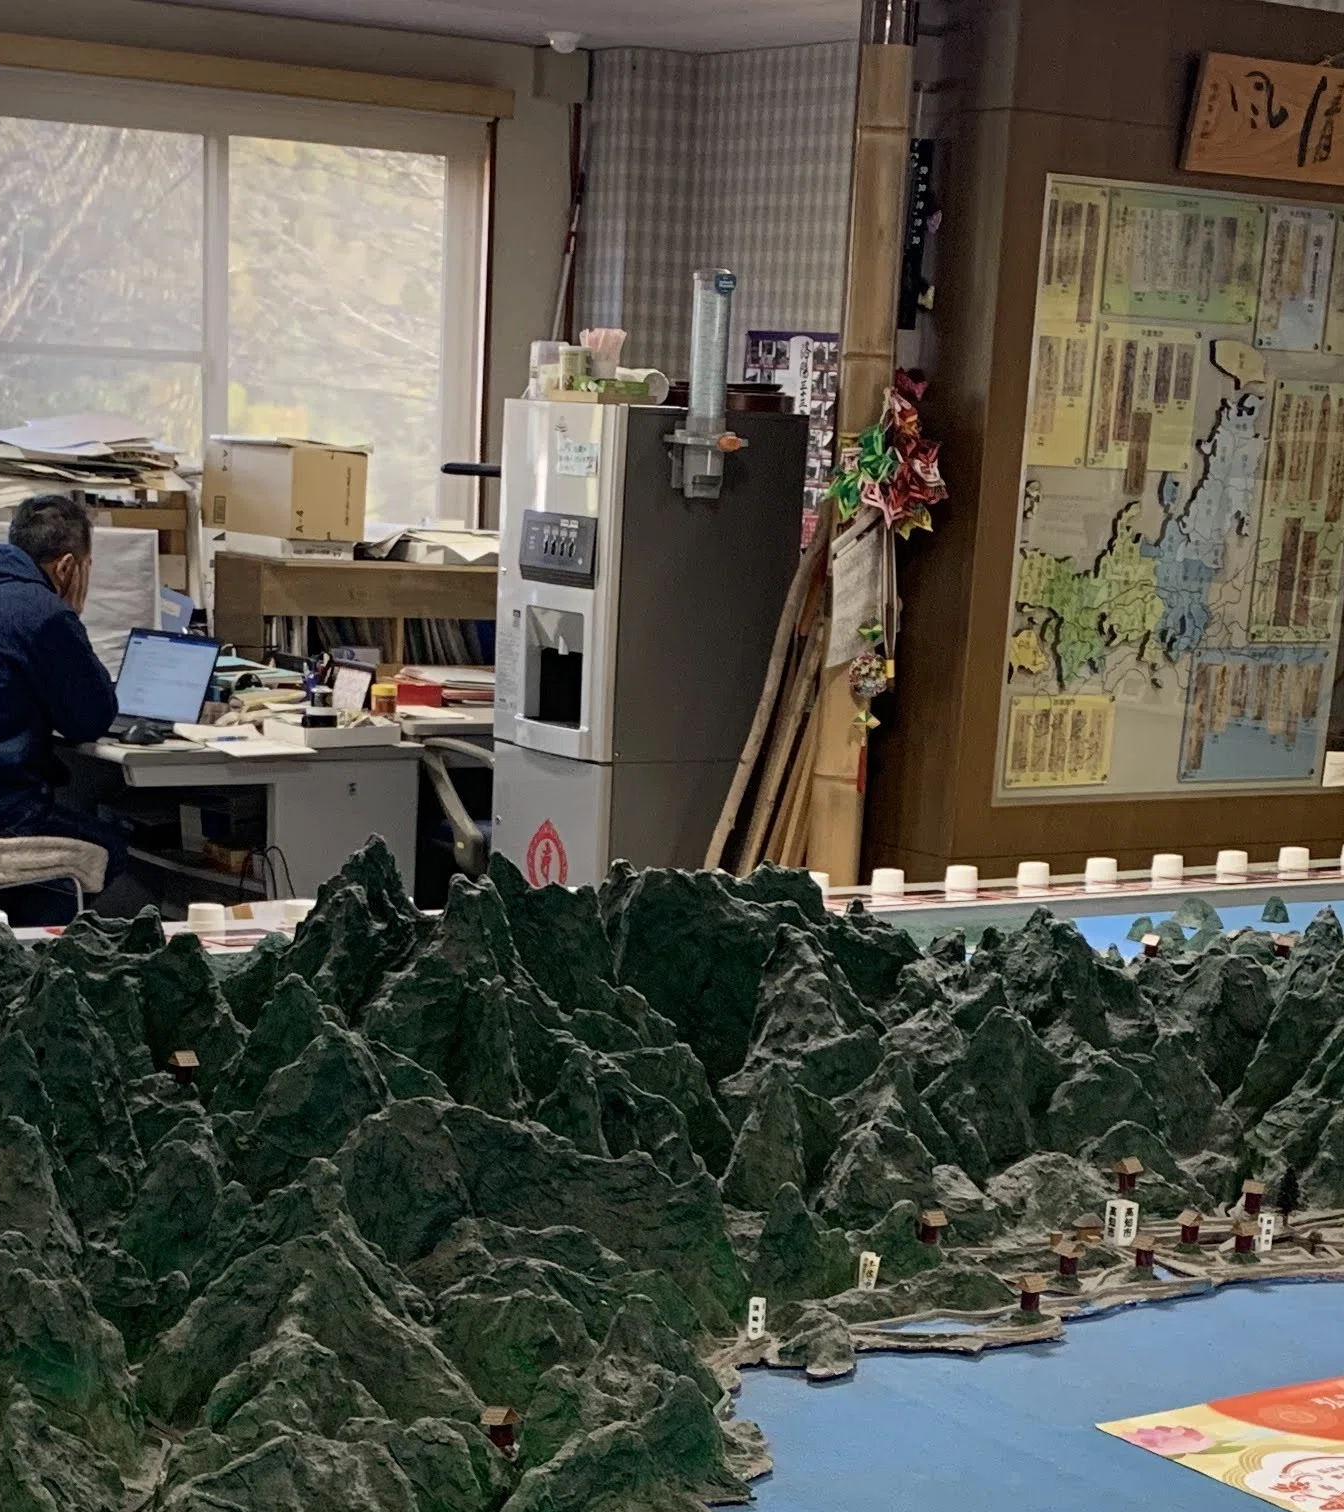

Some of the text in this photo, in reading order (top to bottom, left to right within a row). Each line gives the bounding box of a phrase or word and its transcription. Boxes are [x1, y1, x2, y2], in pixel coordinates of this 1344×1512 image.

[1107, 1206, 1117, 1237] 高知市
[1123, 1207, 1134, 1238] 高知市
